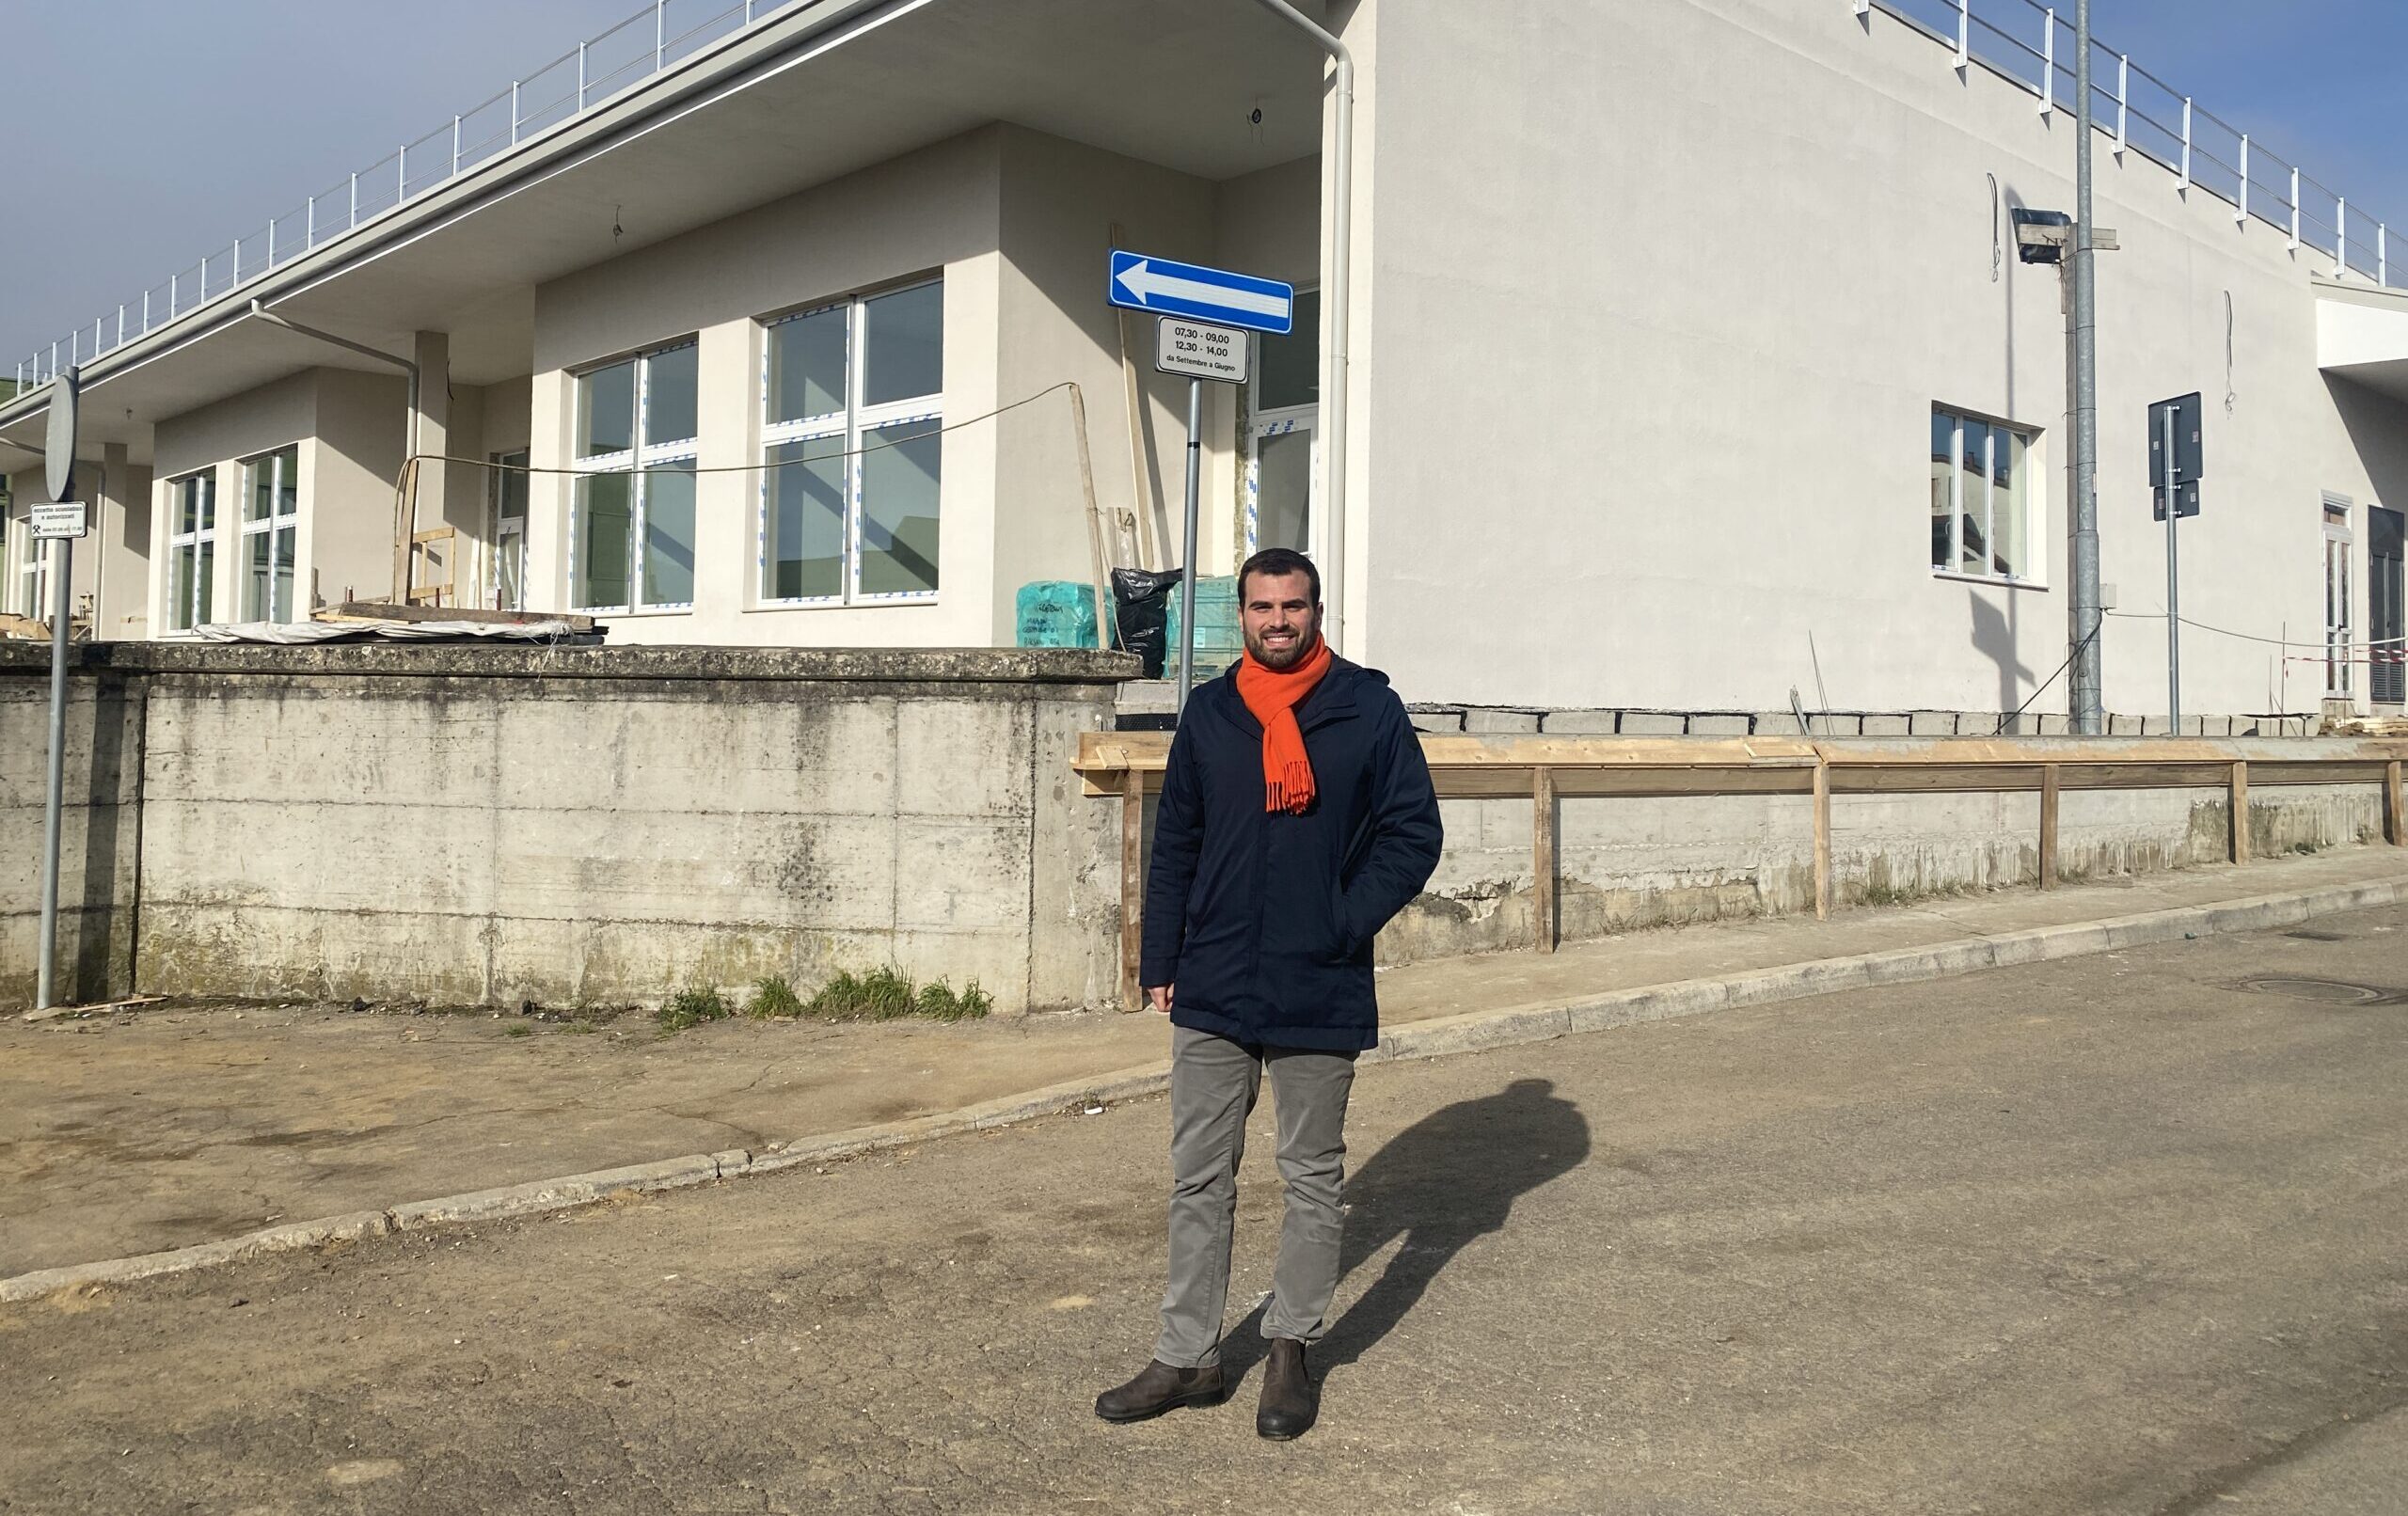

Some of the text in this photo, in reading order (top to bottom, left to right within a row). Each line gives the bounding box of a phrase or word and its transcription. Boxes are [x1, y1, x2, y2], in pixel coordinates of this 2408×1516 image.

[1175, 327, 1197, 339] 07,30
[1205, 332, 1229, 344] 09,00
[1175, 340, 1197, 352] 12,30
[1206, 346, 1228, 356] 14,00
[1176, 356, 1207, 367] Settembre
[1215, 363, 1236, 371] Giugno
